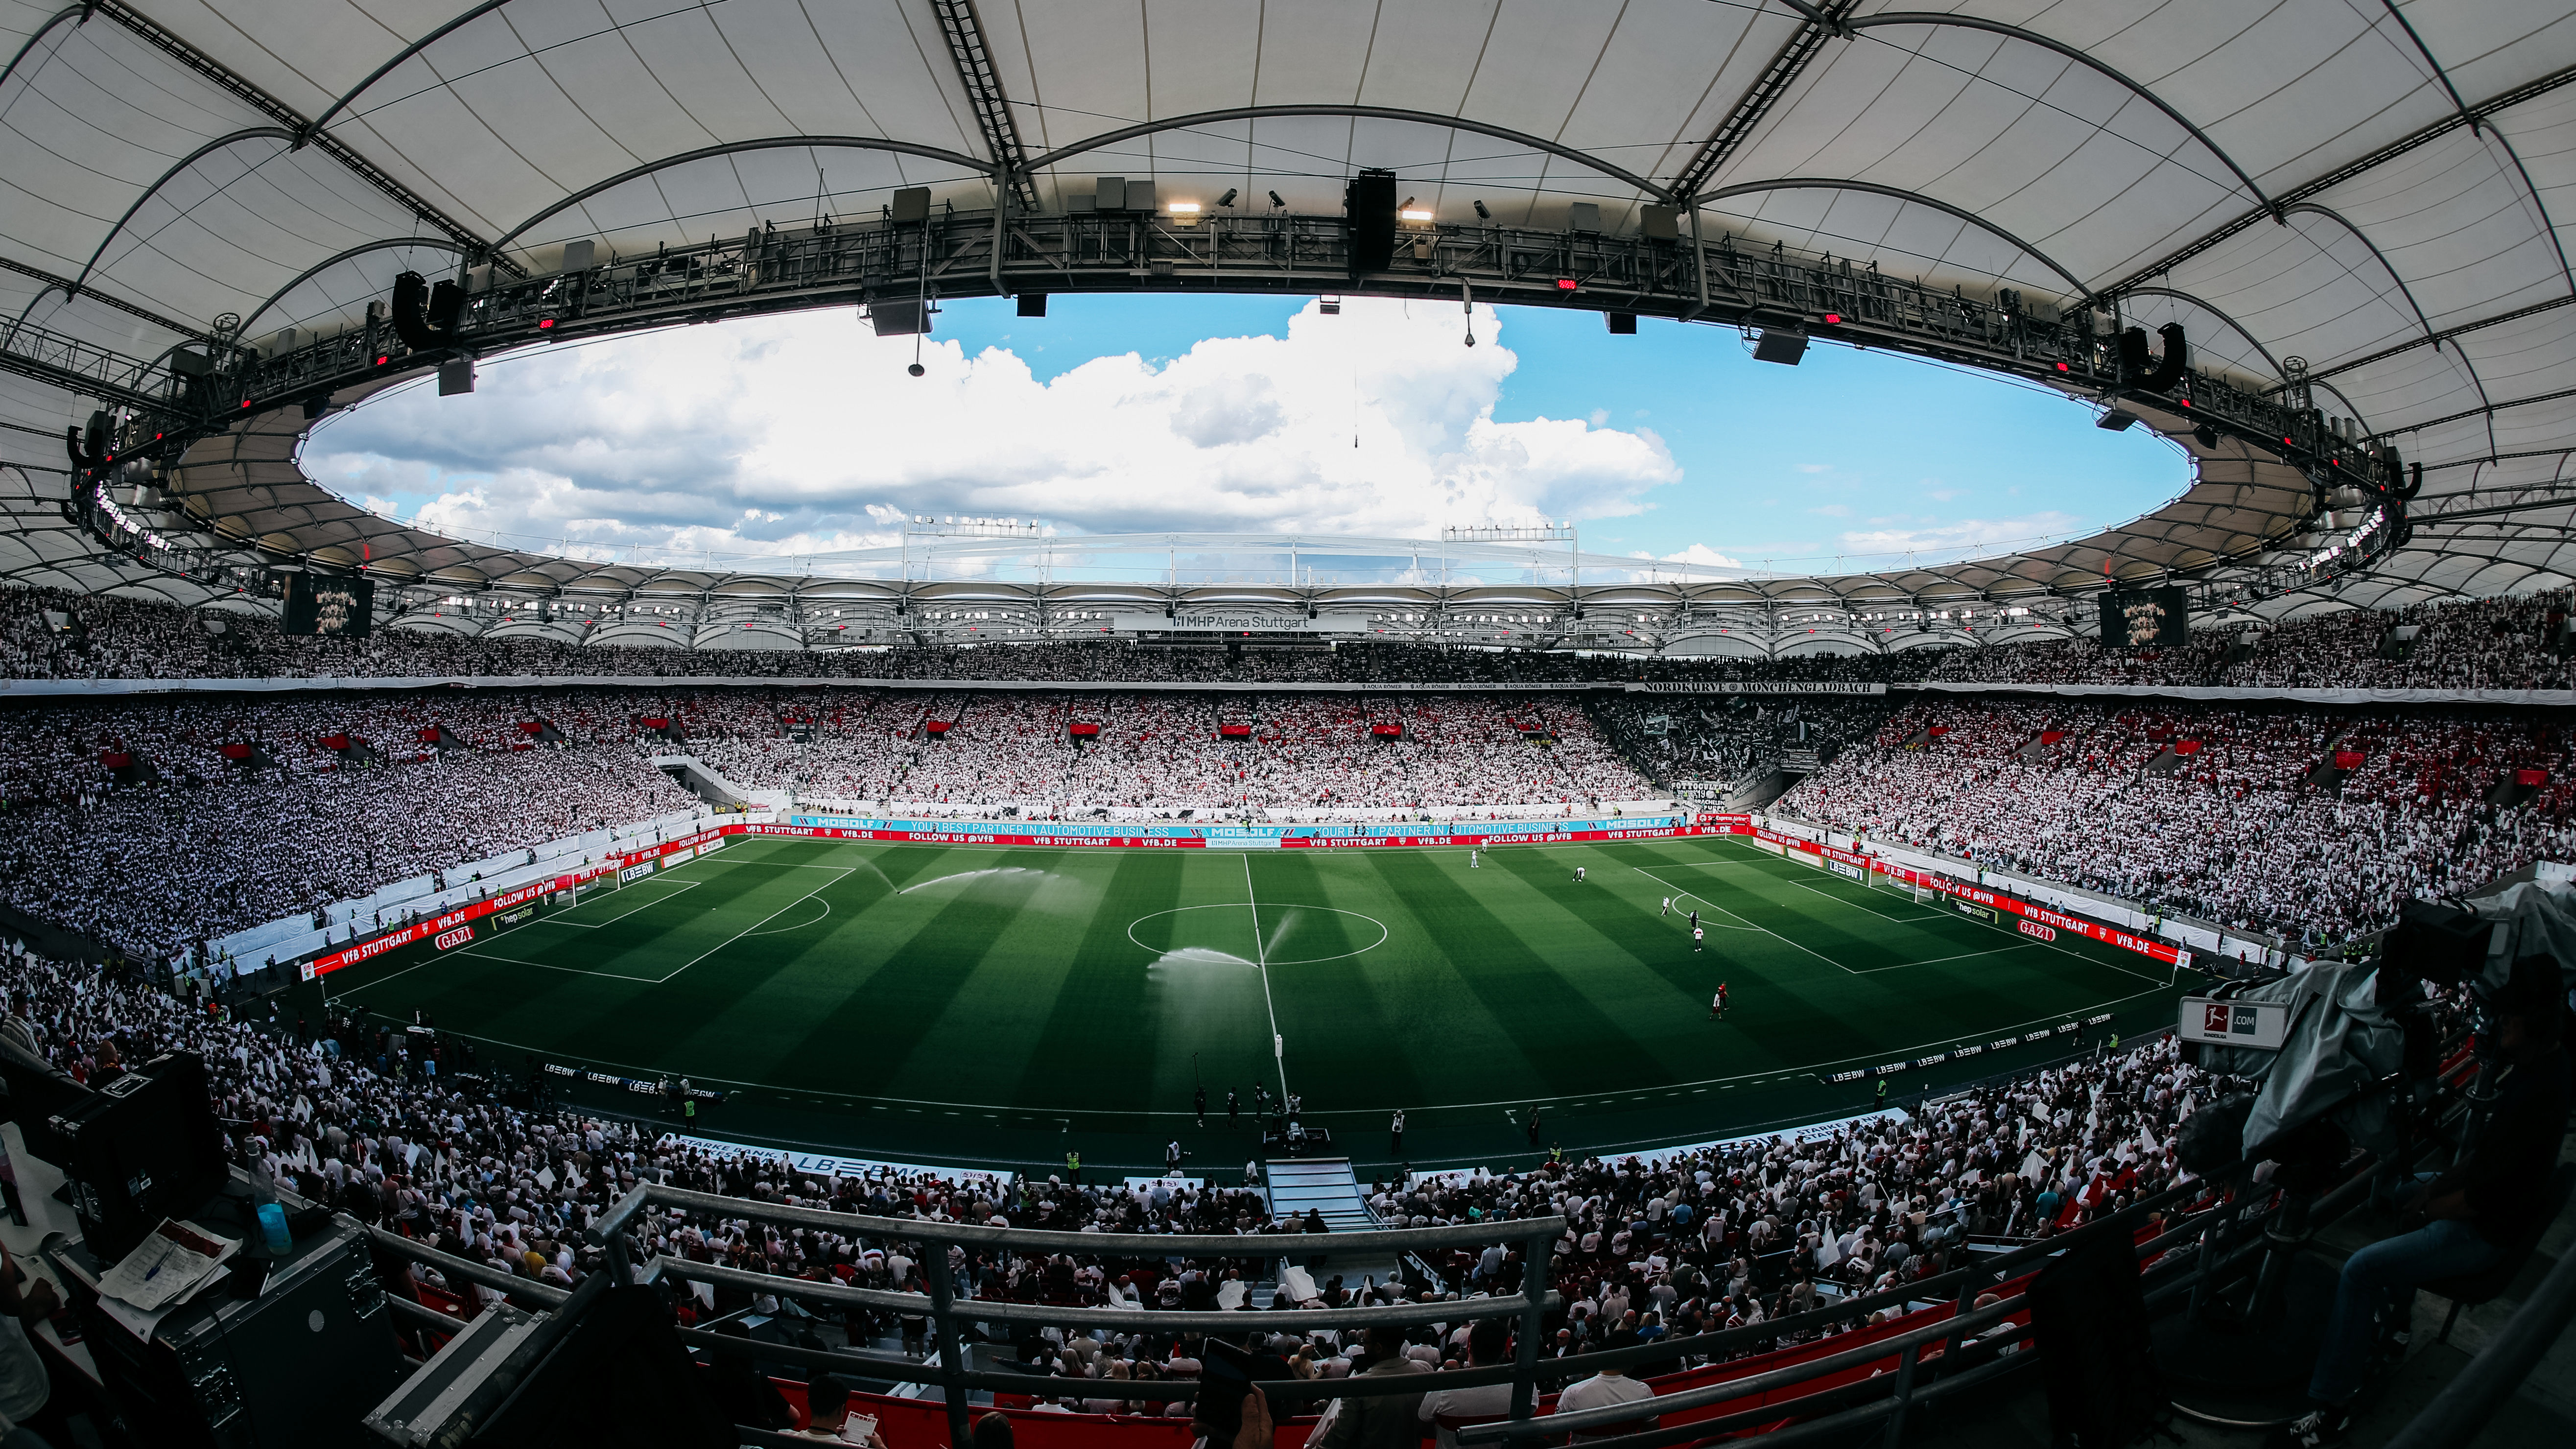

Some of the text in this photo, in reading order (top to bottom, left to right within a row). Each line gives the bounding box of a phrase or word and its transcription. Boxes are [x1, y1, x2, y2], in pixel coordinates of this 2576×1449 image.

[1187, 616, 1308, 630] MHP Arena Stuttgart
[765, 826, 814, 835] STUTTGART
[818, 818, 874, 829] MOSOLF
[911, 821, 1169, 836] YOUR BEST PARTNER IN AUTOMOTIVE BUSINESS
[1315, 827, 1349, 837] YOUR
[1383, 826, 1435, 836] PARTNER
[1436, 825, 1445, 834] IN
[1518, 822, 1568, 832] BUSINESS
[1607, 819, 1660, 829] MOSOLF
[679, 829, 720, 848] FOLLOW US @VfB
[841, 830, 873, 839] VfB.DE
[909, 832, 949, 841] FOLLOW
[1211, 828, 1275, 837] MOSOLF
[1489, 834, 1530, 843] FOLLOW
[1547, 832, 1572, 842] @VfB
[1626, 829, 1675, 838] STUTTGART
[1757, 830, 1777, 840] FOLLOW
[1786, 838, 1800, 847] @VfB
[1054, 837, 1111, 846] STUTTGART
[1330, 838, 1387, 846] STUTTGART
[641, 847, 661, 859] VfB.DE
[1820, 847, 1831, 856] VfB
[1832, 851, 1865, 866] STUTTGART
[580, 871, 591, 880] VfB
[494, 881, 556, 909] FOLLOW US @VfB
[1962, 887, 1971, 897] US
[1973, 890, 1994, 903] @VfB
[437, 911, 465, 929] VfB.DE
[2024, 905, 2089, 934] VfB STUTTGART
[441, 928, 472, 948] GAZI
[2020, 922, 2050, 941] GAZI
[342, 929, 412, 964] VfB STUTTGART
[2117, 933, 2150, 954] VfB.DE
[2234, 1015, 2254, 1025] .COM
[1796, 1123, 1844, 1135] STARKE
[681, 1139, 778, 1158] STARKE BANK.
